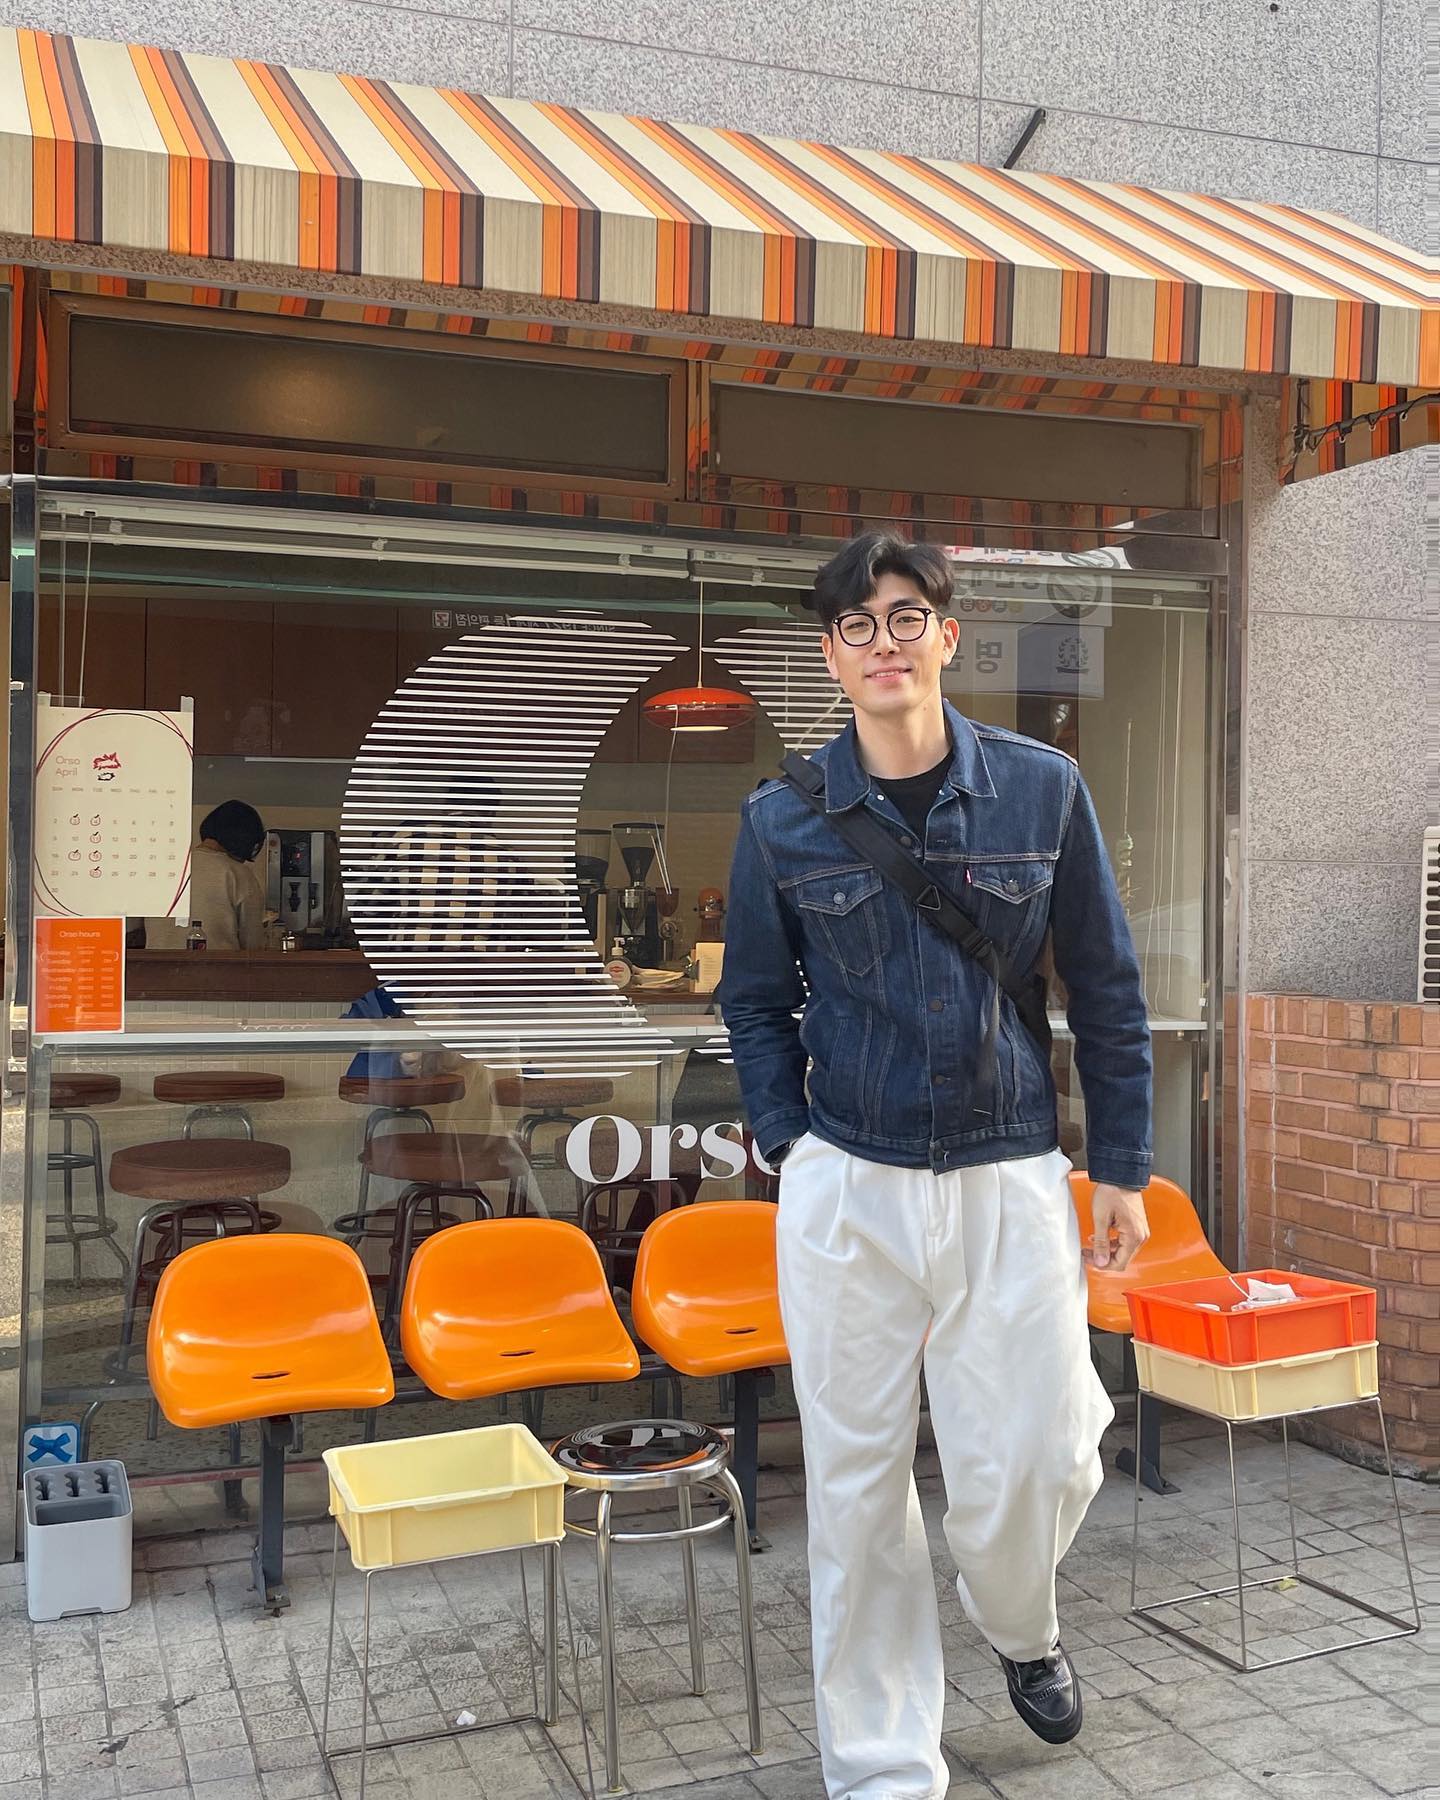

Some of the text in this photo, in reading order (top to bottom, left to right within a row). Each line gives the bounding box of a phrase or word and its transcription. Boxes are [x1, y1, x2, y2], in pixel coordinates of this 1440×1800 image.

[55, 755, 81, 765] Orso
[55, 767, 78, 778] April
[78, 930, 101, 938] hours
[565, 1114, 782, 1184] Ors
